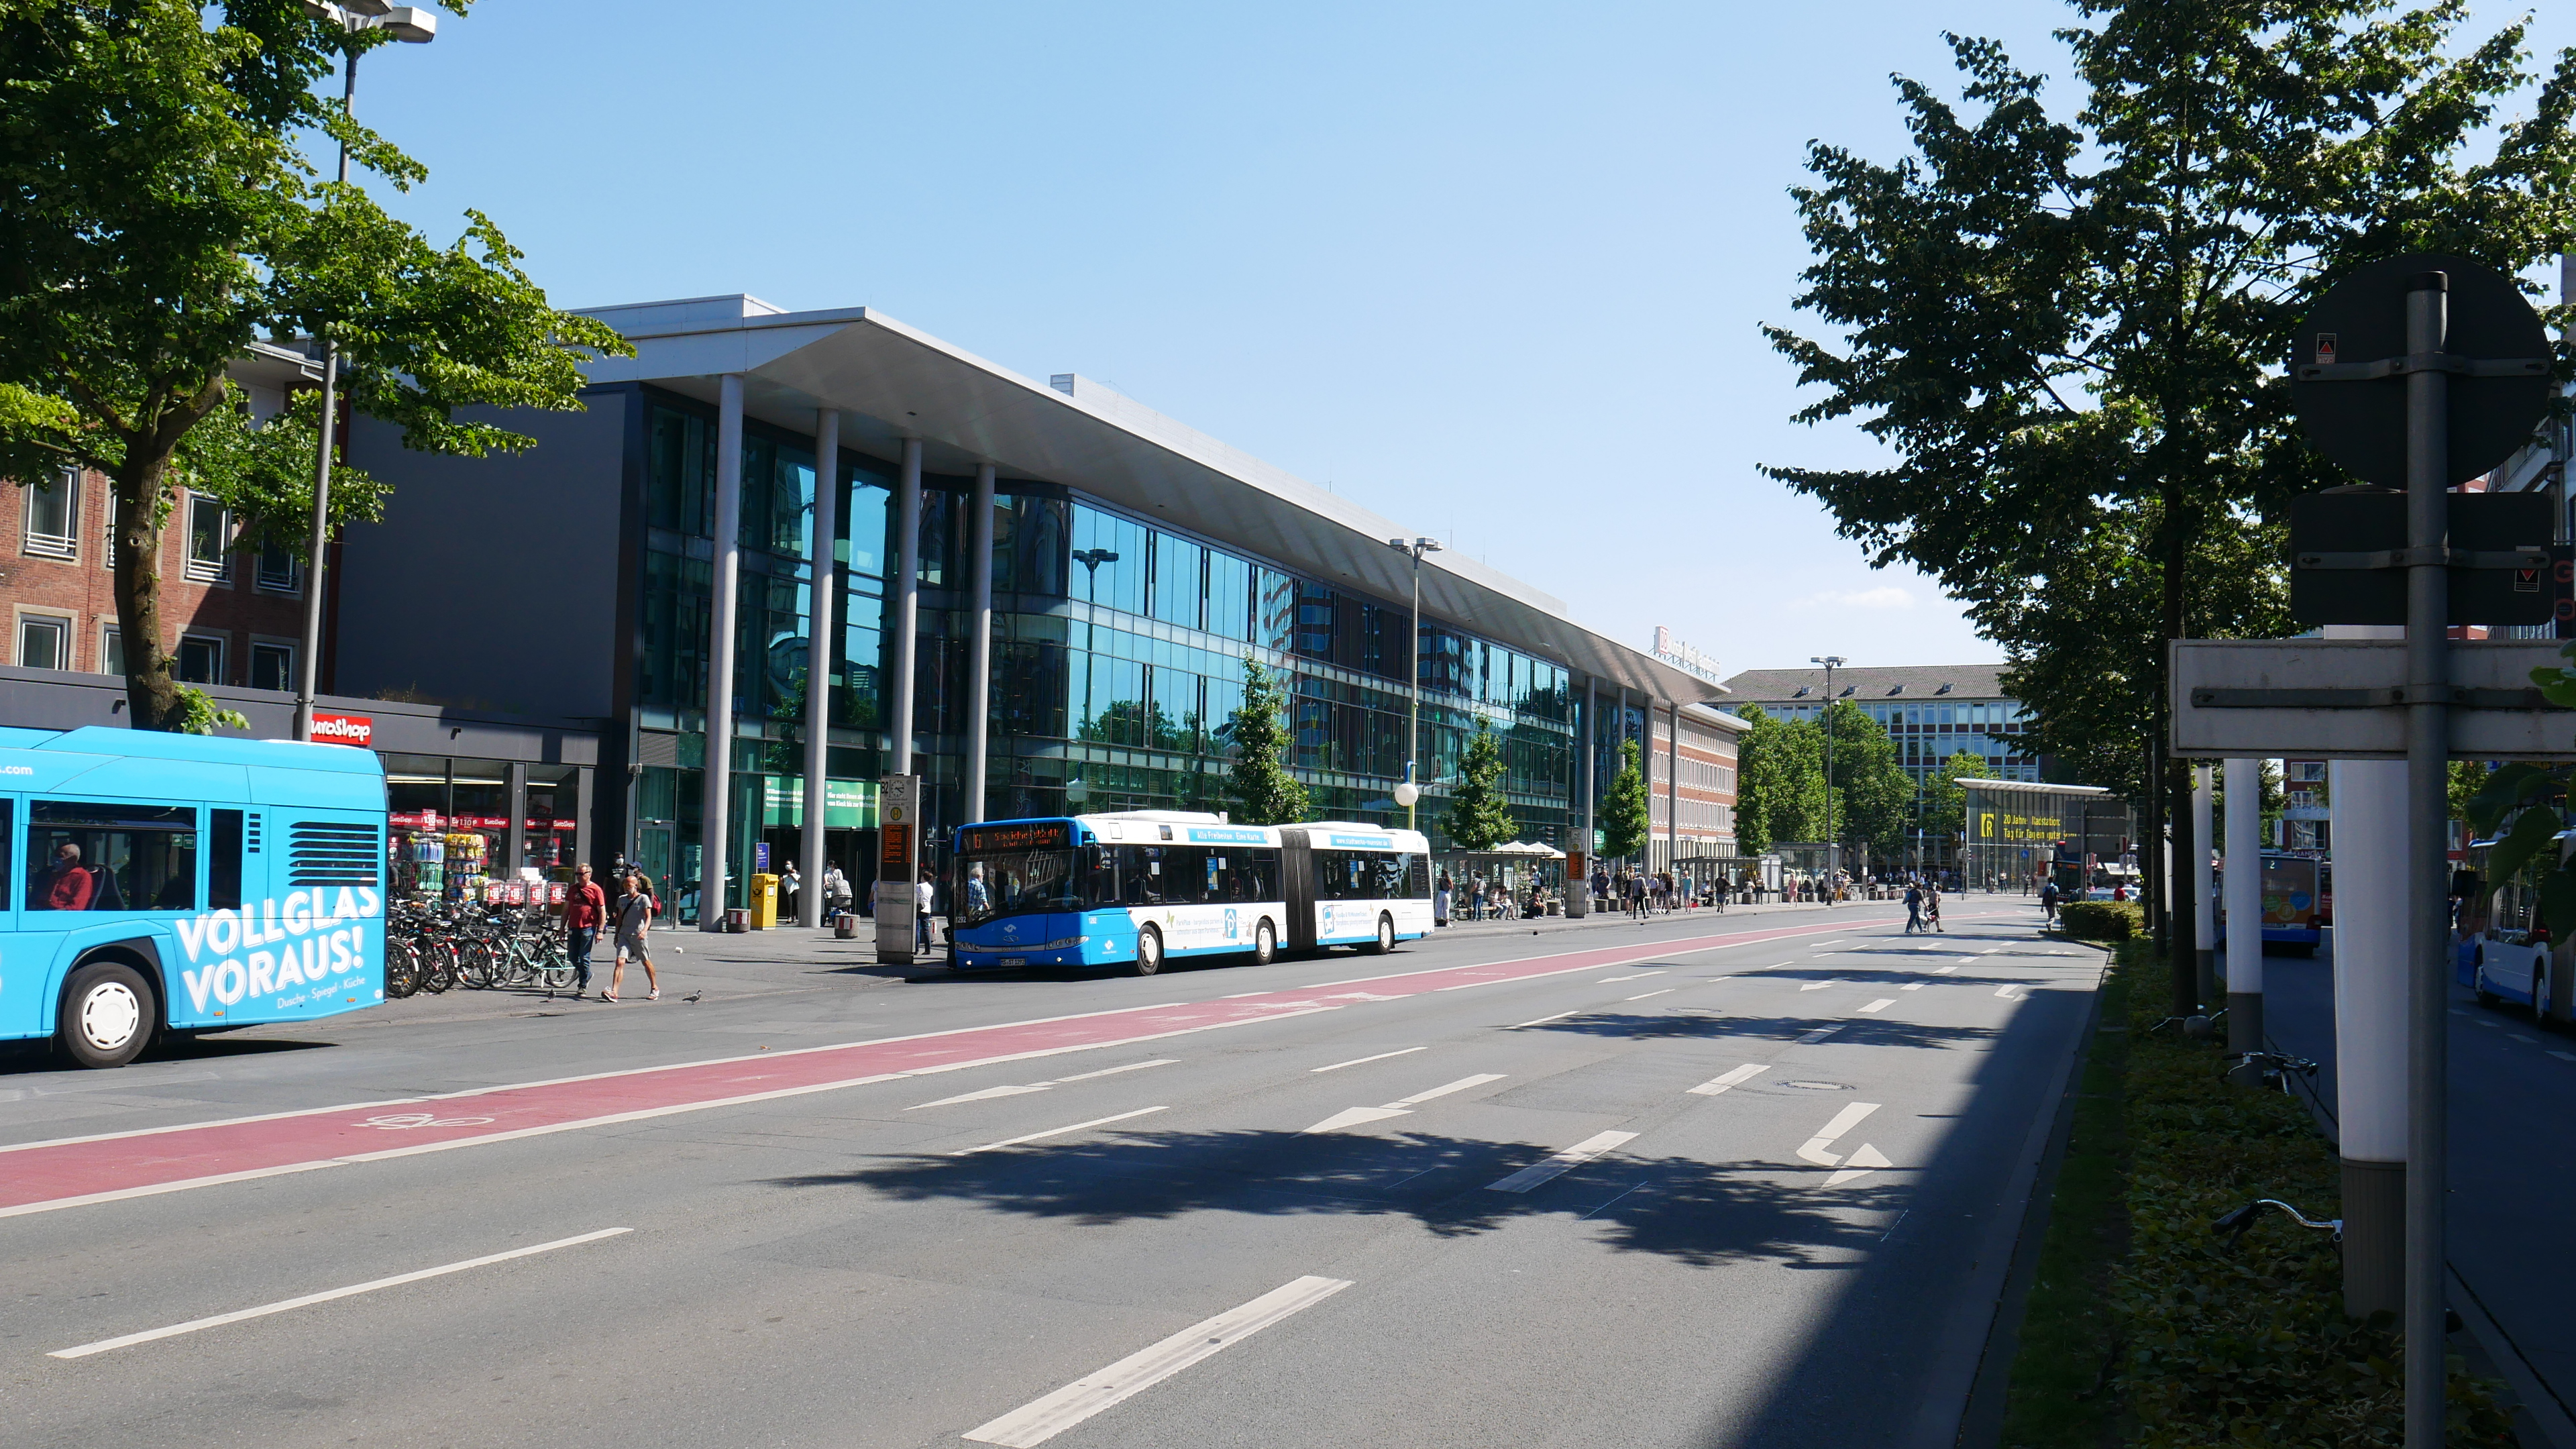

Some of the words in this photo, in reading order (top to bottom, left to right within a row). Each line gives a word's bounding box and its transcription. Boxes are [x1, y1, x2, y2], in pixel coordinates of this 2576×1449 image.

[1661, 630, 1668, 649] DB
[311, 718, 370, 742] uroShop
[881, 781, 889, 794] B2
[460, 818, 472, 826] 1.10
[553, 820, 576, 828] EuroShop
[2004, 814, 2011, 824] 20
[2012, 814, 2028, 825] Jahre
[1197, 831, 1208, 839] Alle
[1208, 831, 1234, 840] Freiheiten.
[1236, 832, 1246, 840] Eine
[1246, 833, 1261, 841] Karte.
[2004, 828, 2014, 841] Tag
[2015, 828, 2024, 839] für
[2026, 828, 2035, 841] Tag
[2036, 829, 2045, 839] ein
[2047, 830, 2061, 841] guter
[1436, 863, 1442, 876] B1
[2269, 861, 2275, 869] 2
[176, 877, 379, 963] VOLLGLAS
[183, 926, 364, 1014] VORAUS!
[278, 994, 305, 1008] Dusche
[311, 982, 337, 1000] Spiegel
[343, 975, 365, 989] Küche
